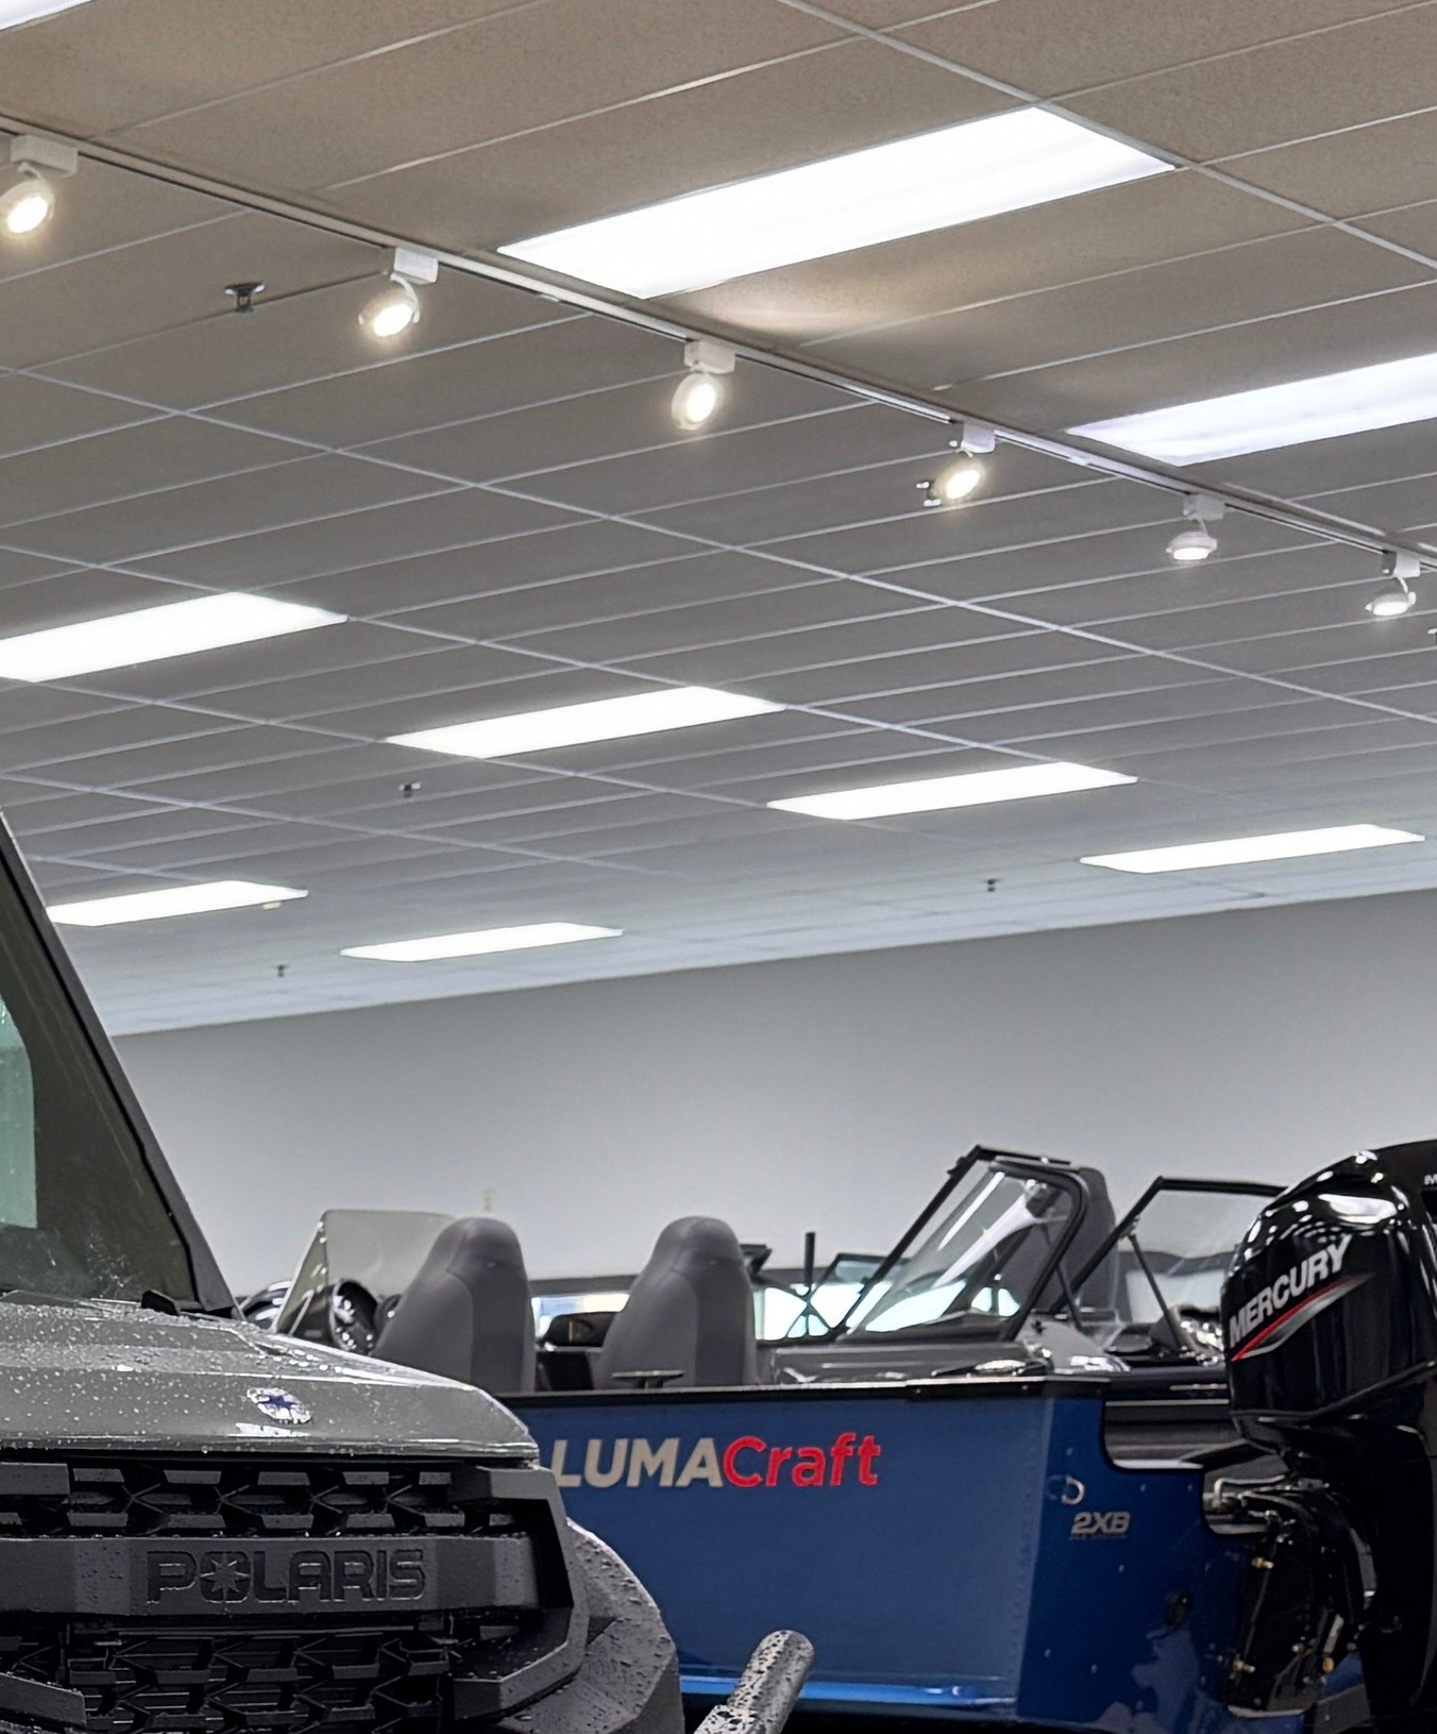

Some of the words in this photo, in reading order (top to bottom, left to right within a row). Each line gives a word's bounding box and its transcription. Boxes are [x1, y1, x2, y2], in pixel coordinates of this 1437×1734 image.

[1229, 1233, 1352, 1349] MERCURY
[550, 1431, 882, 1488] LUMACraft
[1070, 1511, 1132, 1535] 2XB
[146, 1549, 426, 1604] POLARIS
